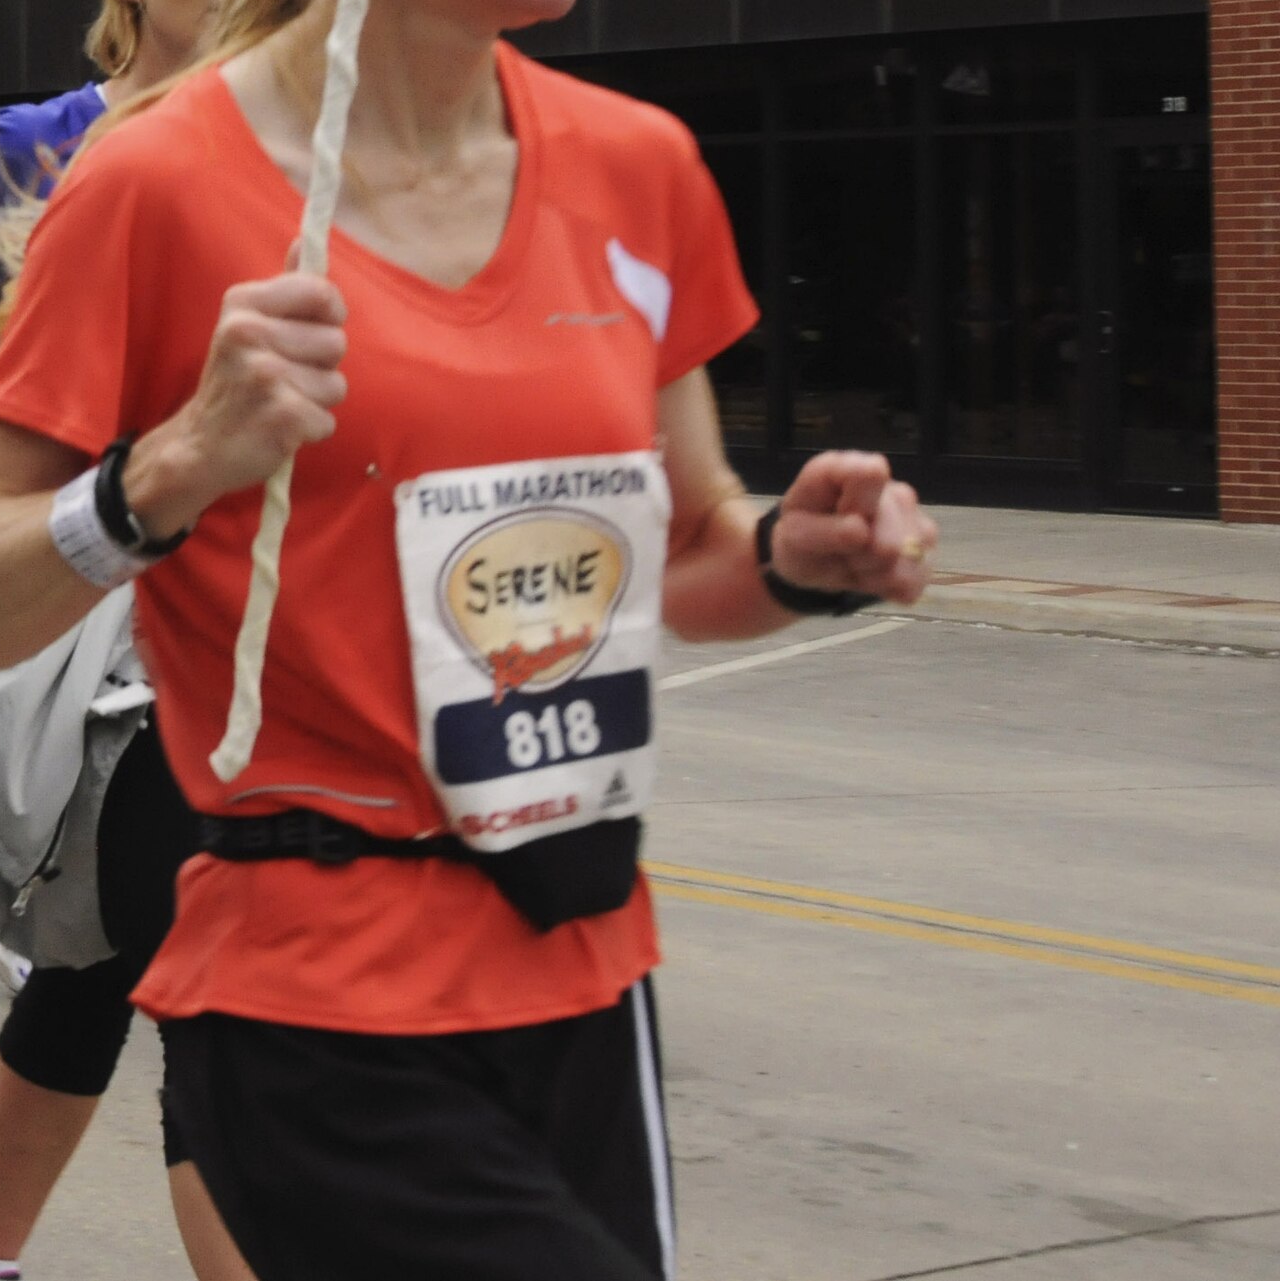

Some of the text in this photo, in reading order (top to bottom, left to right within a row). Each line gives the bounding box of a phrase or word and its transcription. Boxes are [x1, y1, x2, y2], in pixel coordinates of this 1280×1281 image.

[418, 467, 647, 518] FULL MARATHON
[465, 549, 602, 616] SERENE
[504, 699, 602, 769] 818
